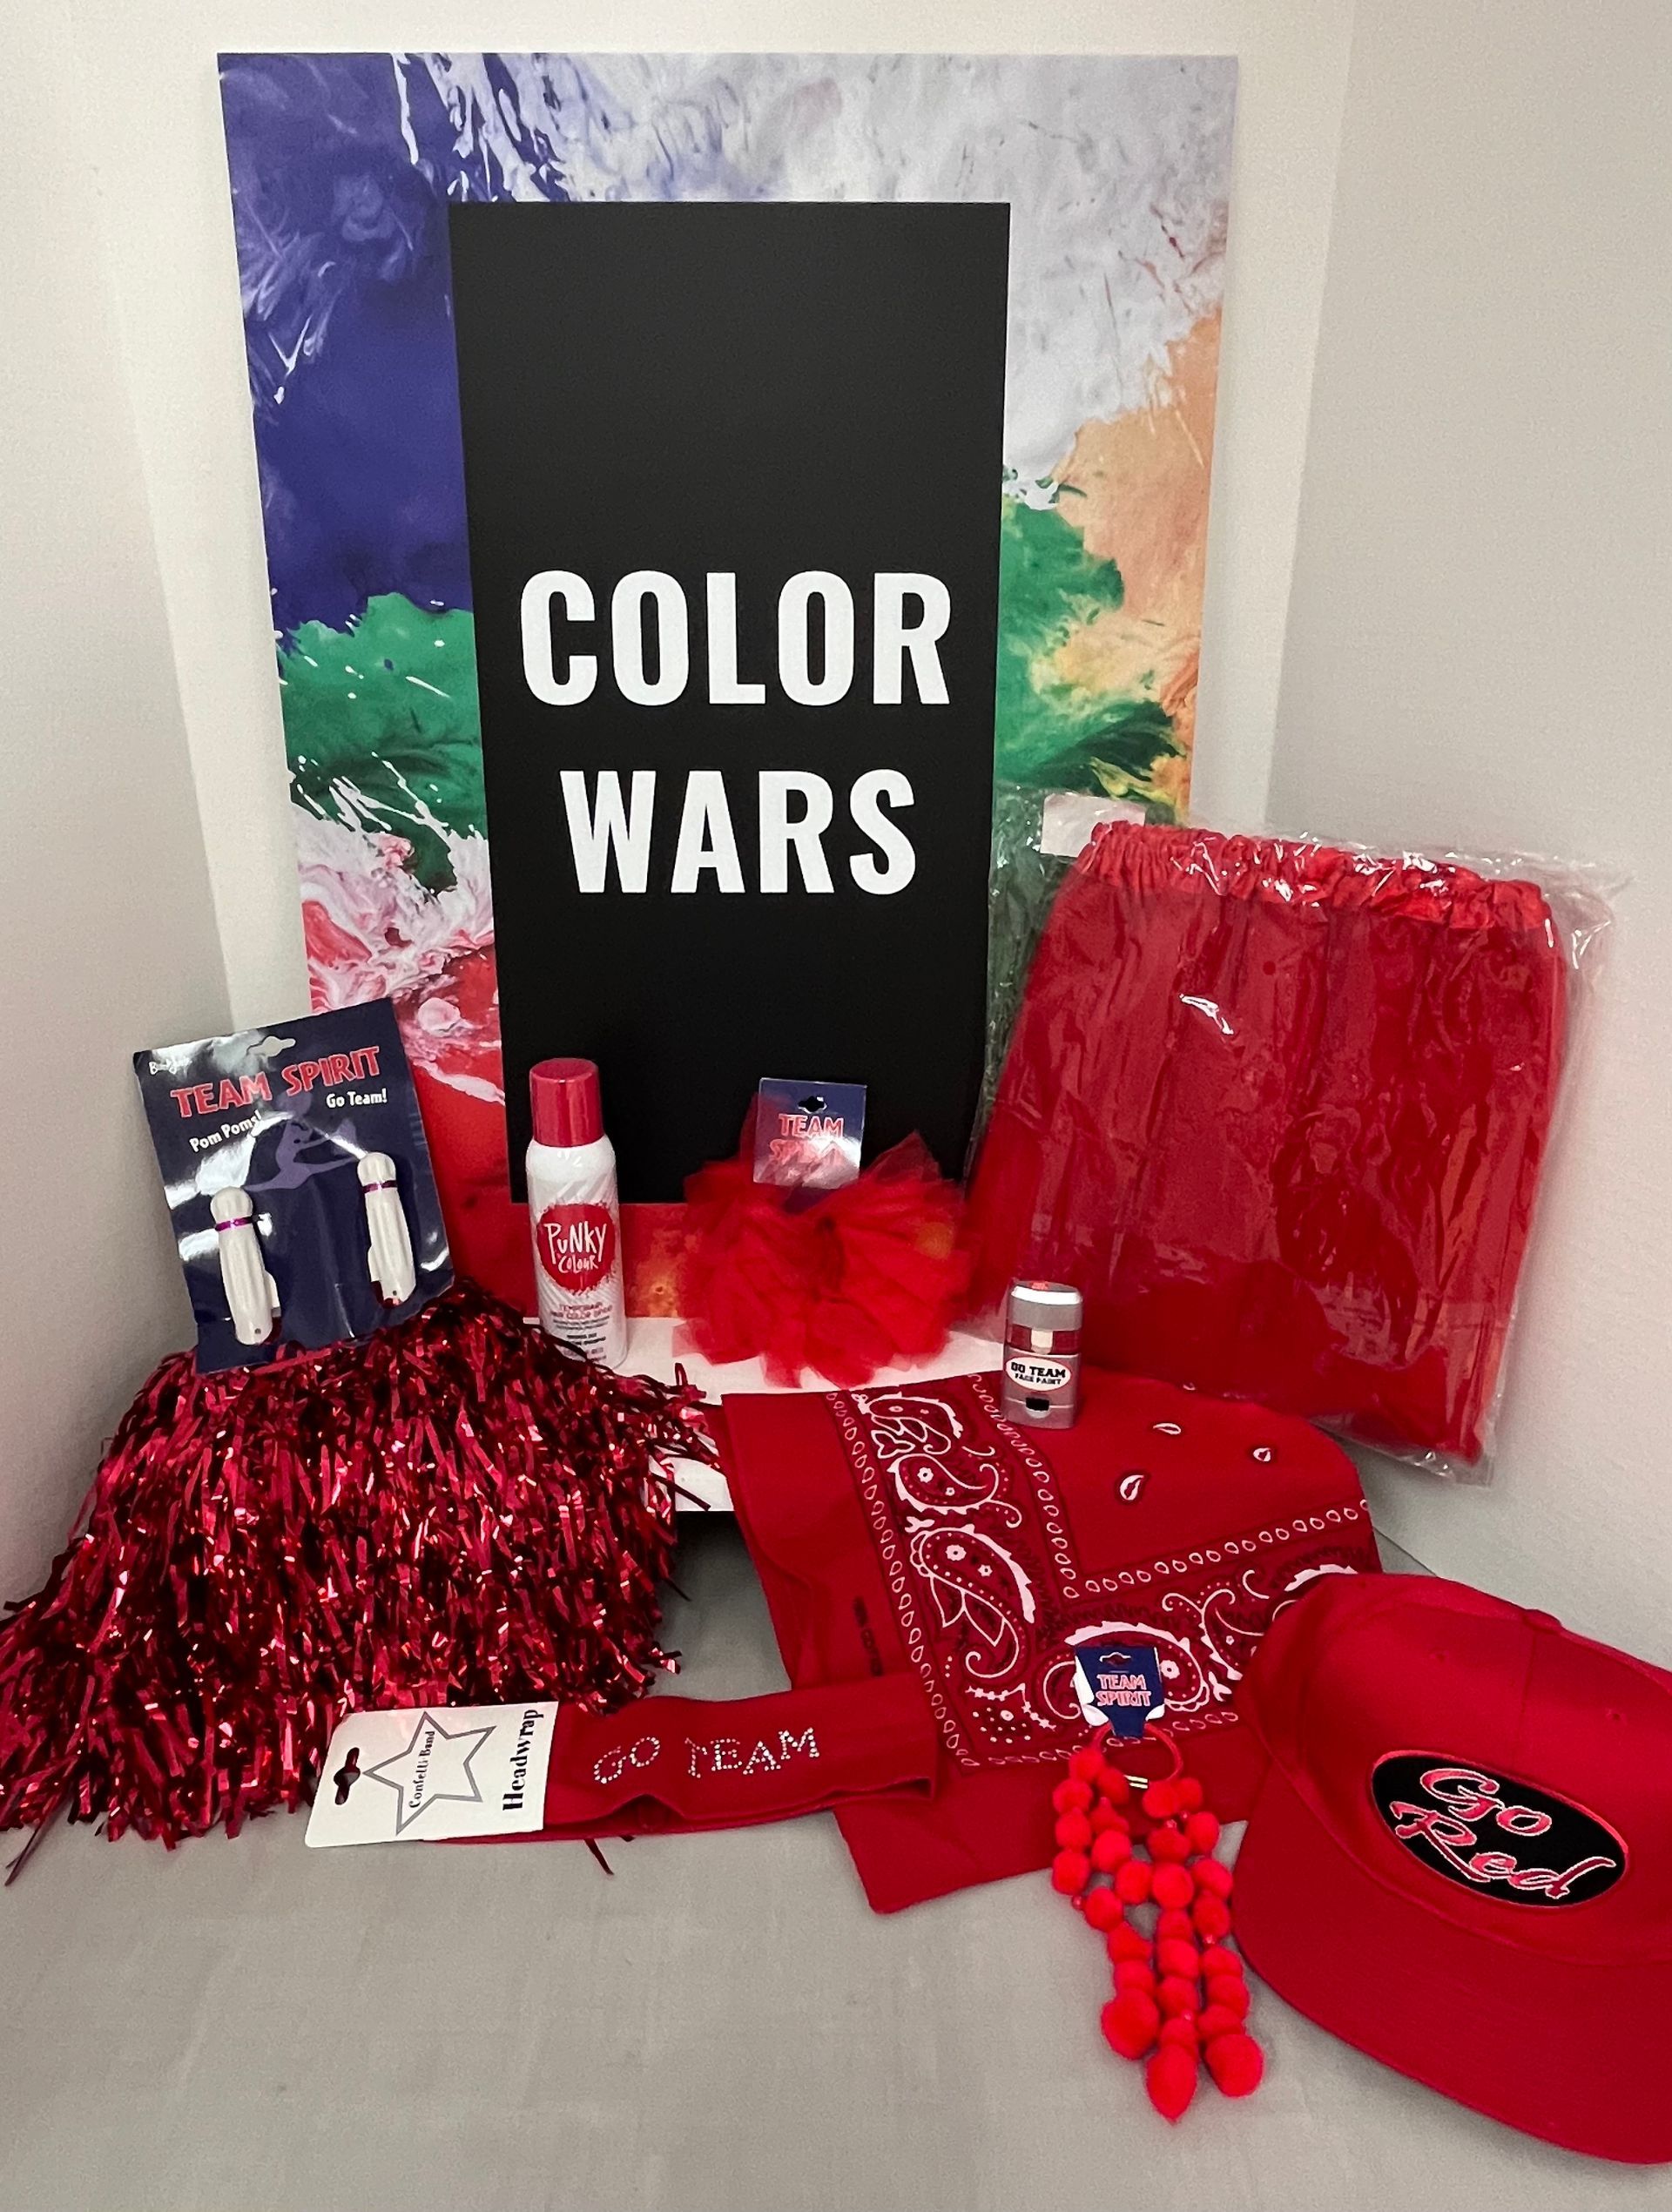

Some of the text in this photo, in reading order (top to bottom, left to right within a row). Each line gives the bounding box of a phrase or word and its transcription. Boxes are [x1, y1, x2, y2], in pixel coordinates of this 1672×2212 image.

[521, 569, 952, 706] COLOR
[560, 768, 917, 896] WARS
[170, 1045, 381, 1118] TEAM SPIRIT
[326, 1088, 388, 1109] Go Team!
[189, 1109, 262, 1153] Pom Poms!
[778, 1113, 845, 1139] TEAM
[1029, 1366, 1067, 1379] TEAM
[1096, 1674, 1147, 1690] TEAM
[1096, 1690, 1152, 1707] SPIRIT
[502, 1709, 544, 1811] Headwrap
[593, 1726, 820, 1784] GO TEAM
[1419, 1768, 1553, 1837] Go
[1389, 1801, 1616, 1899] Red
